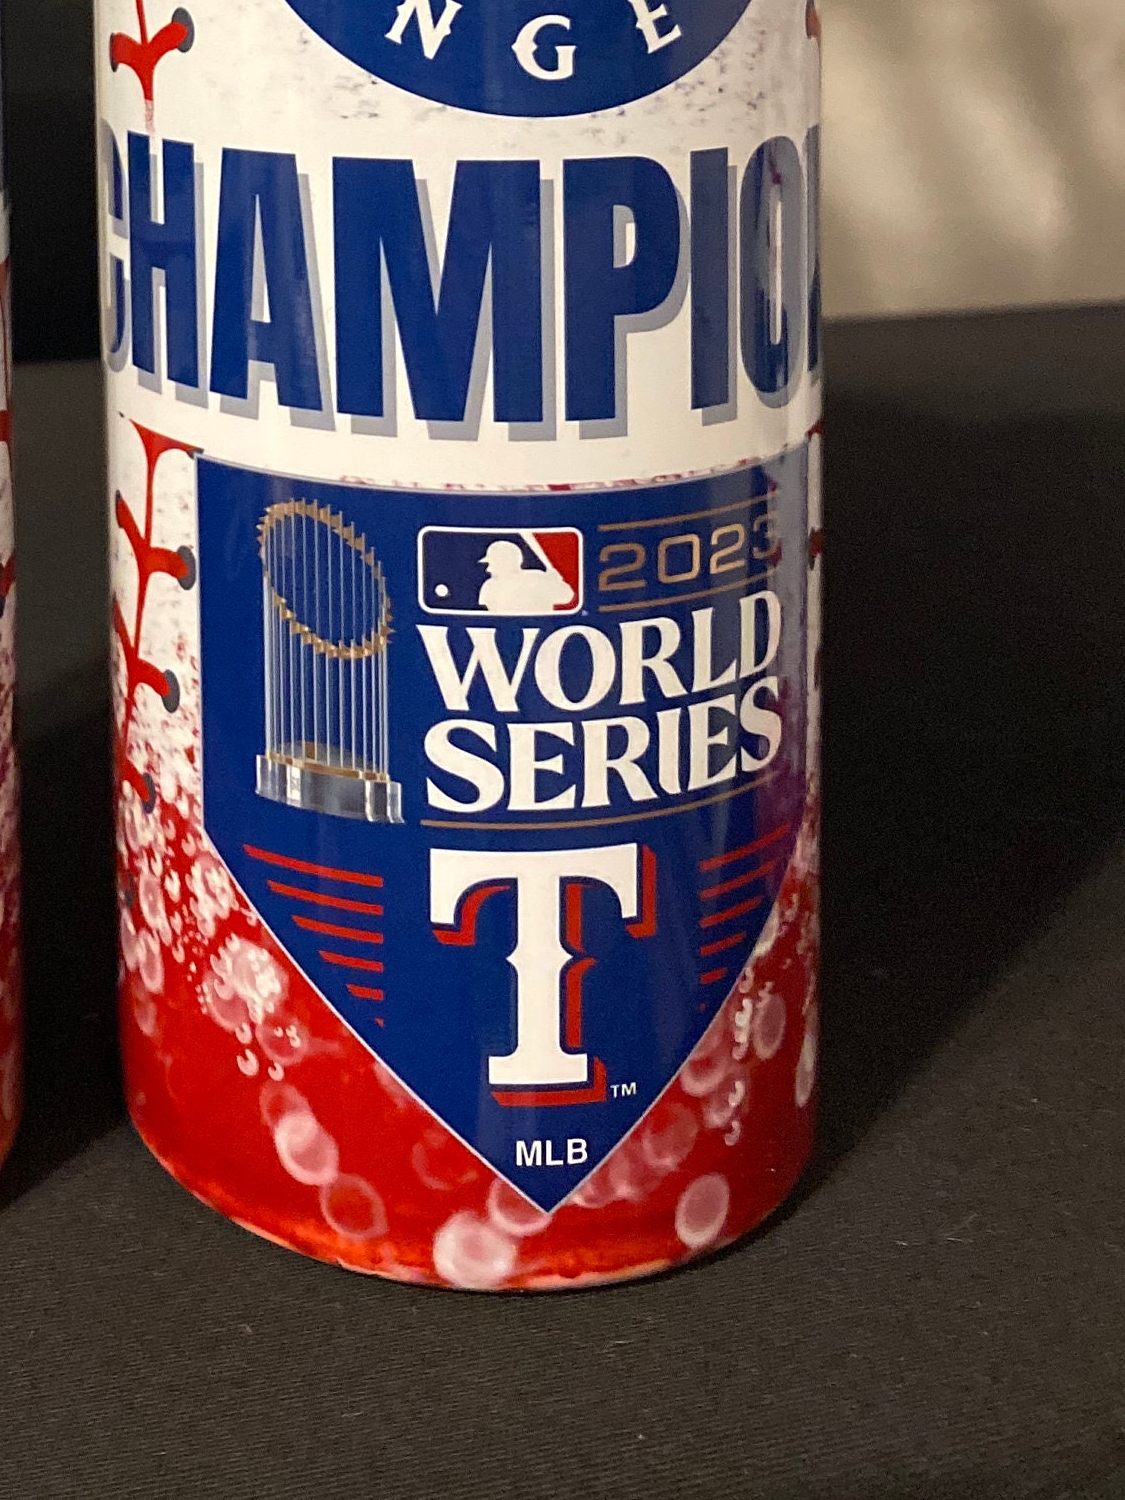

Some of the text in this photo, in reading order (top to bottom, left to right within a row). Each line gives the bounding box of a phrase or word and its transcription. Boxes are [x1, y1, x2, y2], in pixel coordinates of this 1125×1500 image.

[598, 512, 780, 592] 2023
[416, 589, 783, 713] WORLD
[423, 675, 783, 815] SERIES
[429, 842, 658, 1107] T
[610, 1082, 638, 1099] TM
[514, 1137, 590, 1168] MLB
